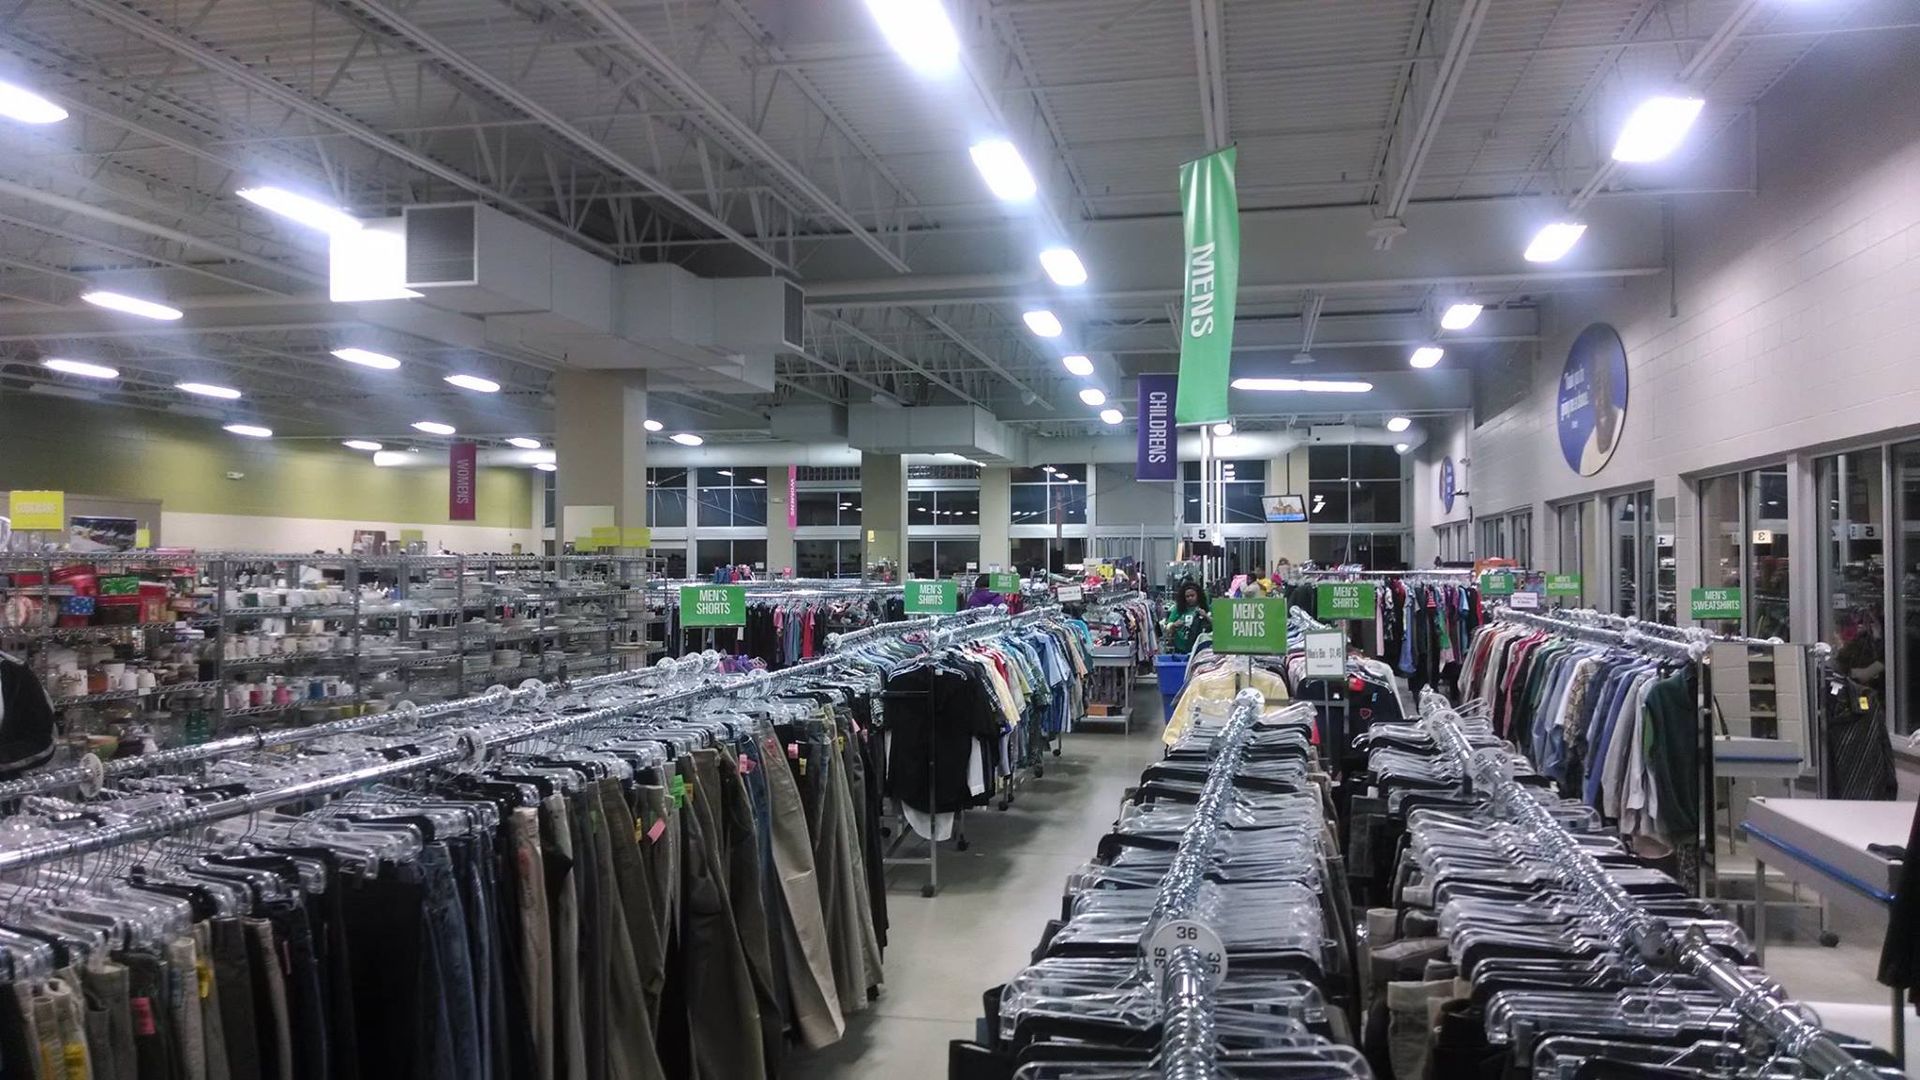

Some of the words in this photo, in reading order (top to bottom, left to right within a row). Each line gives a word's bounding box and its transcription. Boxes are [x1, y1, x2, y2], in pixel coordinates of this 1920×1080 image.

[1190, 240, 1216, 338] MENS
[1148, 391, 1167, 464] CHILDRENS
[456, 459, 470, 504] WOMENS
[1198, 529, 1207, 539] 5
[700, 590, 728, 601] MEN'S
[920, 584, 942, 594] MEN'S
[1333, 586, 1358, 597] MEN'S
[1705, 590, 1727, 600] MEN'S
[696, 602, 731, 614] SHORTS
[1332, 597, 1360, 609] SHIRTS
[1693, 600, 1740, 610] SWEATSHIRTS
[1232, 603, 1265, 620] MEN'S
[1232, 621, 1265, 637] PANTS
[1176, 926, 1198, 940] 36
[1154, 947, 1167, 969] 36
[1208, 952, 1221, 974] 36
